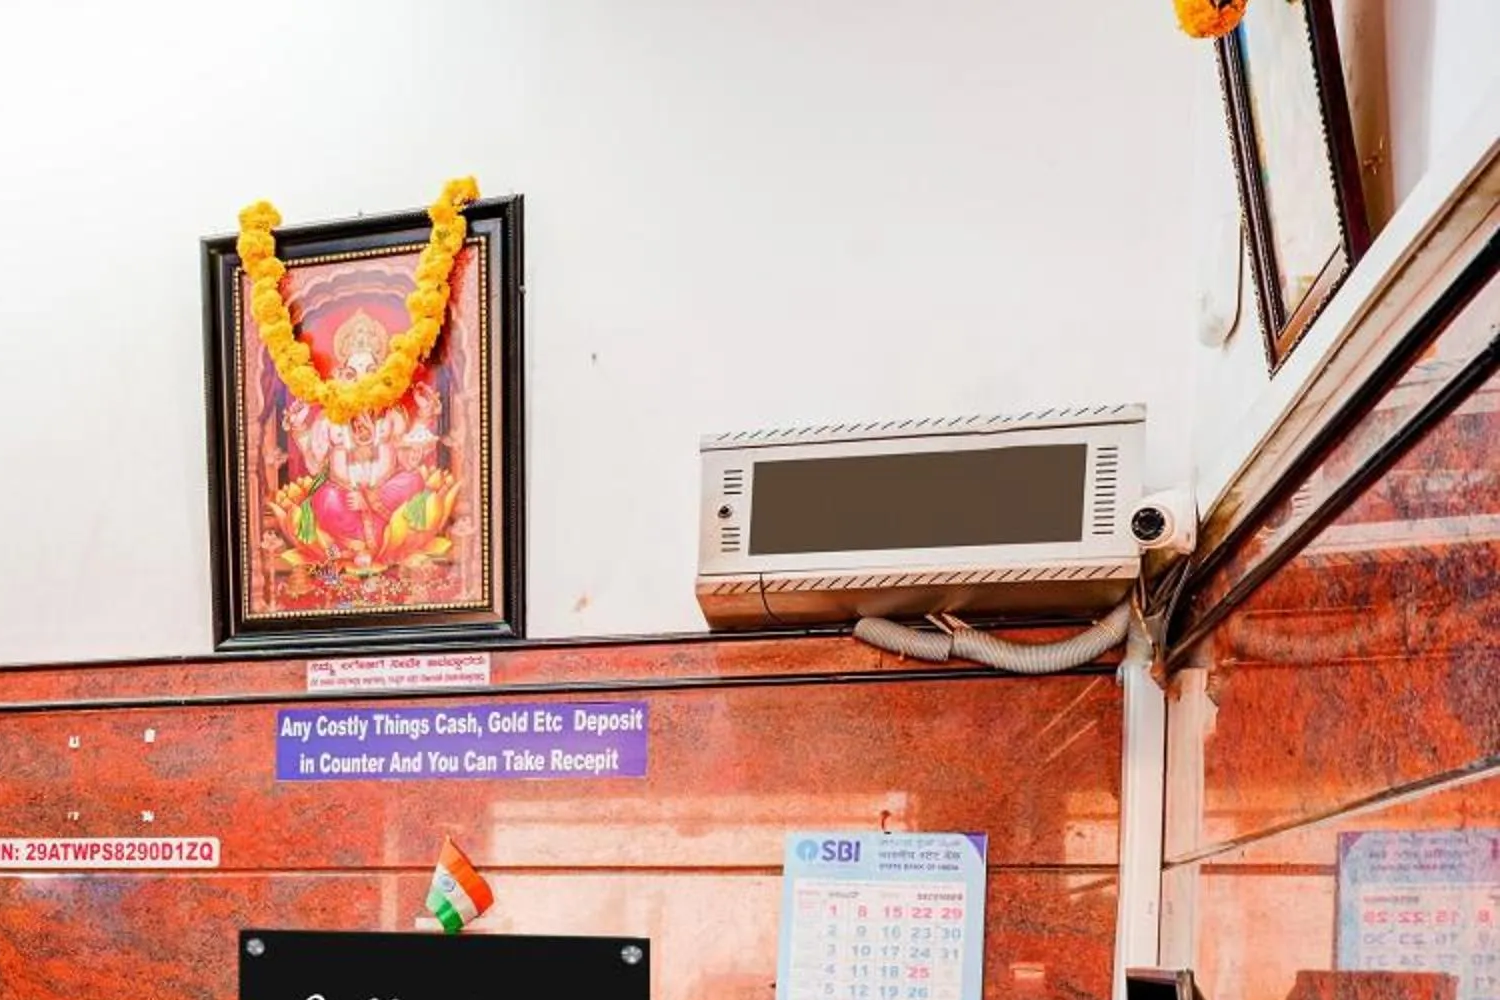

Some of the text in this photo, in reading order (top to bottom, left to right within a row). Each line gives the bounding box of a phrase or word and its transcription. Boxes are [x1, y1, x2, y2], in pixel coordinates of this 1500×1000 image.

[281, 709, 642, 741] Any Costly Things Cash, Gold Etc Deposit
[300, 747, 619, 775] in Counter And You Can Take Recepit
[26, 842, 213, 862] 29ATWPS8290D1ZQ
[821, 840, 860, 863] SBI
[884, 906, 903, 919] 15
[911, 907, 933, 919] 22
[941, 907, 962, 920] 29
[911, 928, 931, 939] 23
[852, 945, 871, 957] 10
[910, 947, 930, 959] 24
[851, 966, 869, 977] 11
[881, 966, 899, 978] 18
[908, 967, 929, 979] 25
[850, 985, 869, 997] 12
[879, 986, 898, 999] 19
[908, 987, 929, 999] 26
